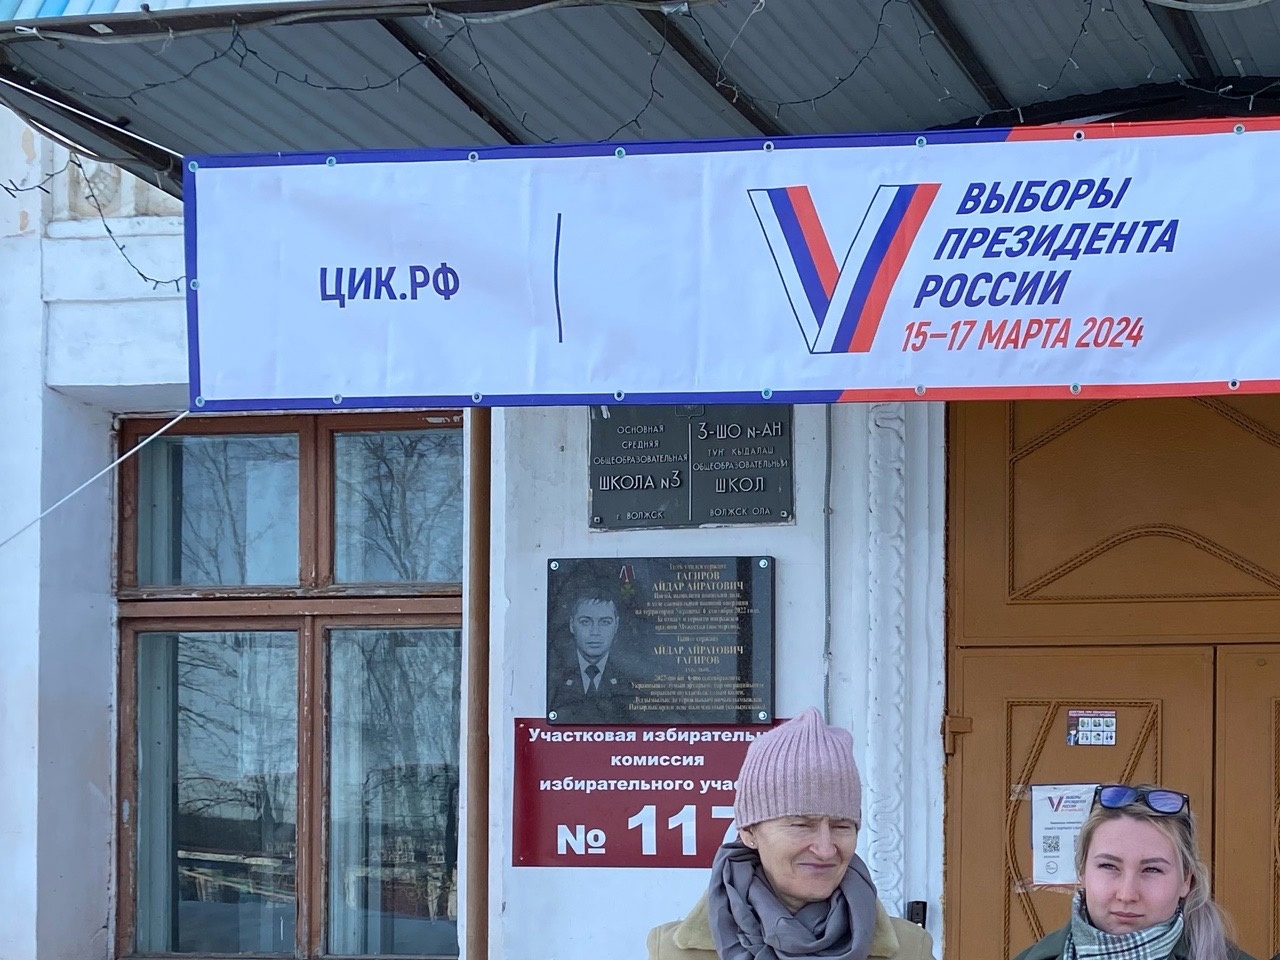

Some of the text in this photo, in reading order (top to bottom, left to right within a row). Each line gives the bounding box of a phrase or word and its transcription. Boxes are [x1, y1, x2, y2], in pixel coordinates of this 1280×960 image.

[955, 176, 1132, 215] ВЫБОРЫ
[933, 219, 1180, 261] ПРЕЗИДЕНТА
[320, 262, 460, 308] ЦИК.РФ
[913, 270, 1071, 308] РОССИИ
[978, 317, 1071, 350] МАРТА
[1075, 316, 1144, 348] 2024
[617, 425, 664, 434] ОСНОВНАЯ
[698, 422, 741, 440] 3-ШО
[621, 440, 659, 449] СРЕДНЯЯ
[732, 446, 774, 456] КЫДАЛАШ
[593, 454, 688, 465] ОБЩЕОБРАЗОВАТЕЛЬНАЯ
[600, 475, 655, 490] ШКОЛА
[715, 477, 765, 493] ШКОЛ
[626, 511, 664, 520] ВОЛЖСК
[710, 507, 771, 517] ВОЛЖСК ОЛА
[528, 728, 637, 743] Участковая
[610, 754, 705, 766] комиссия
[539, 776, 694, 793] избирательного
[557, 824, 606, 855] №
